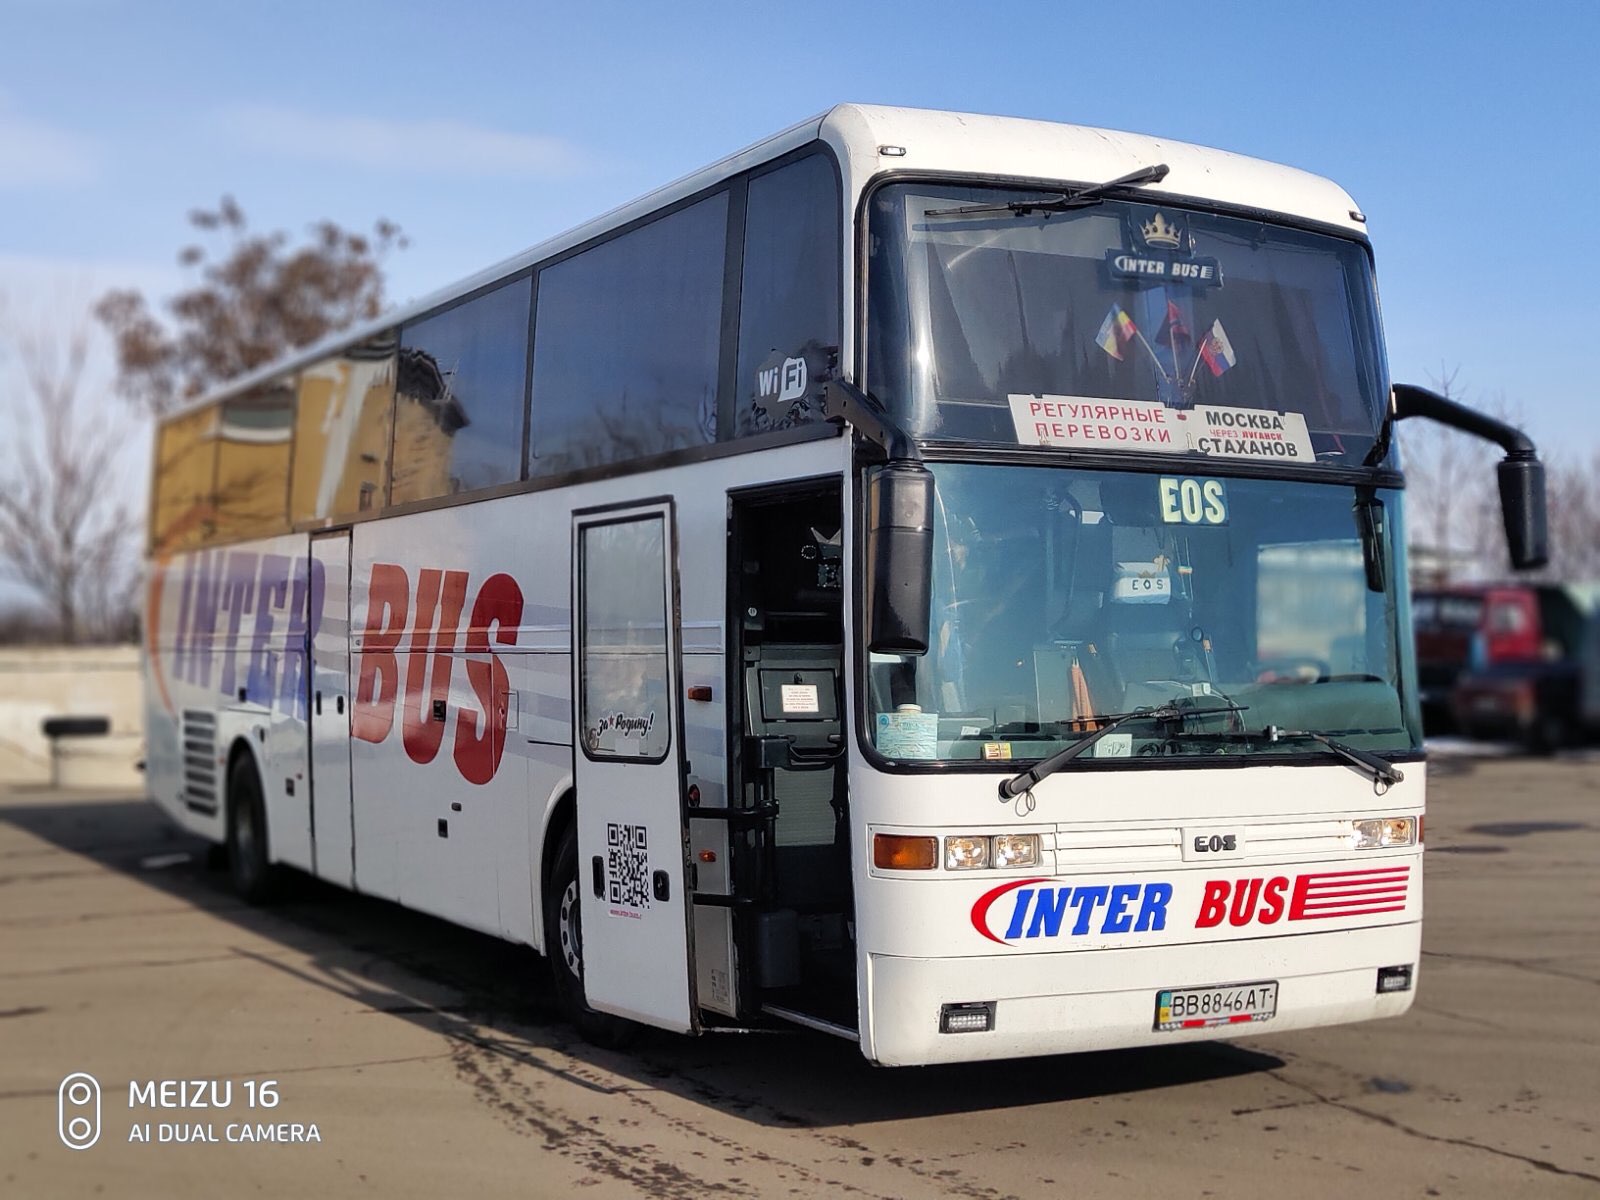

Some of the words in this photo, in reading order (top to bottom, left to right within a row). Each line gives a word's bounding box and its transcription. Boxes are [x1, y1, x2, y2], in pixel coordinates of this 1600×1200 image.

[1123, 258, 1165, 274] INTER
[1172, 263, 1200, 278] BUS
[1029, 402, 1166, 424] РЕГУЛЯРНЫЕ
[1205, 410, 1284, 431] МОСКВА
[1035, 422, 1171, 444] ПЕРЕВОЗКИ
[1210, 429, 1238, 437] ЧЕРЕЗ
[1198, 437, 1298, 457] СТАХАНОВ
[1160, 478, 1226, 524] EOS
[1132, 579, 1164, 591] EOS
[351, 562, 524, 786] BUS
[1194, 834, 1237, 852] EOS
[1004, 882, 1174, 939] INTER
[1194, 876, 1288, 929] BUS
[1172, 988, 1270, 1017] BB8846AT
